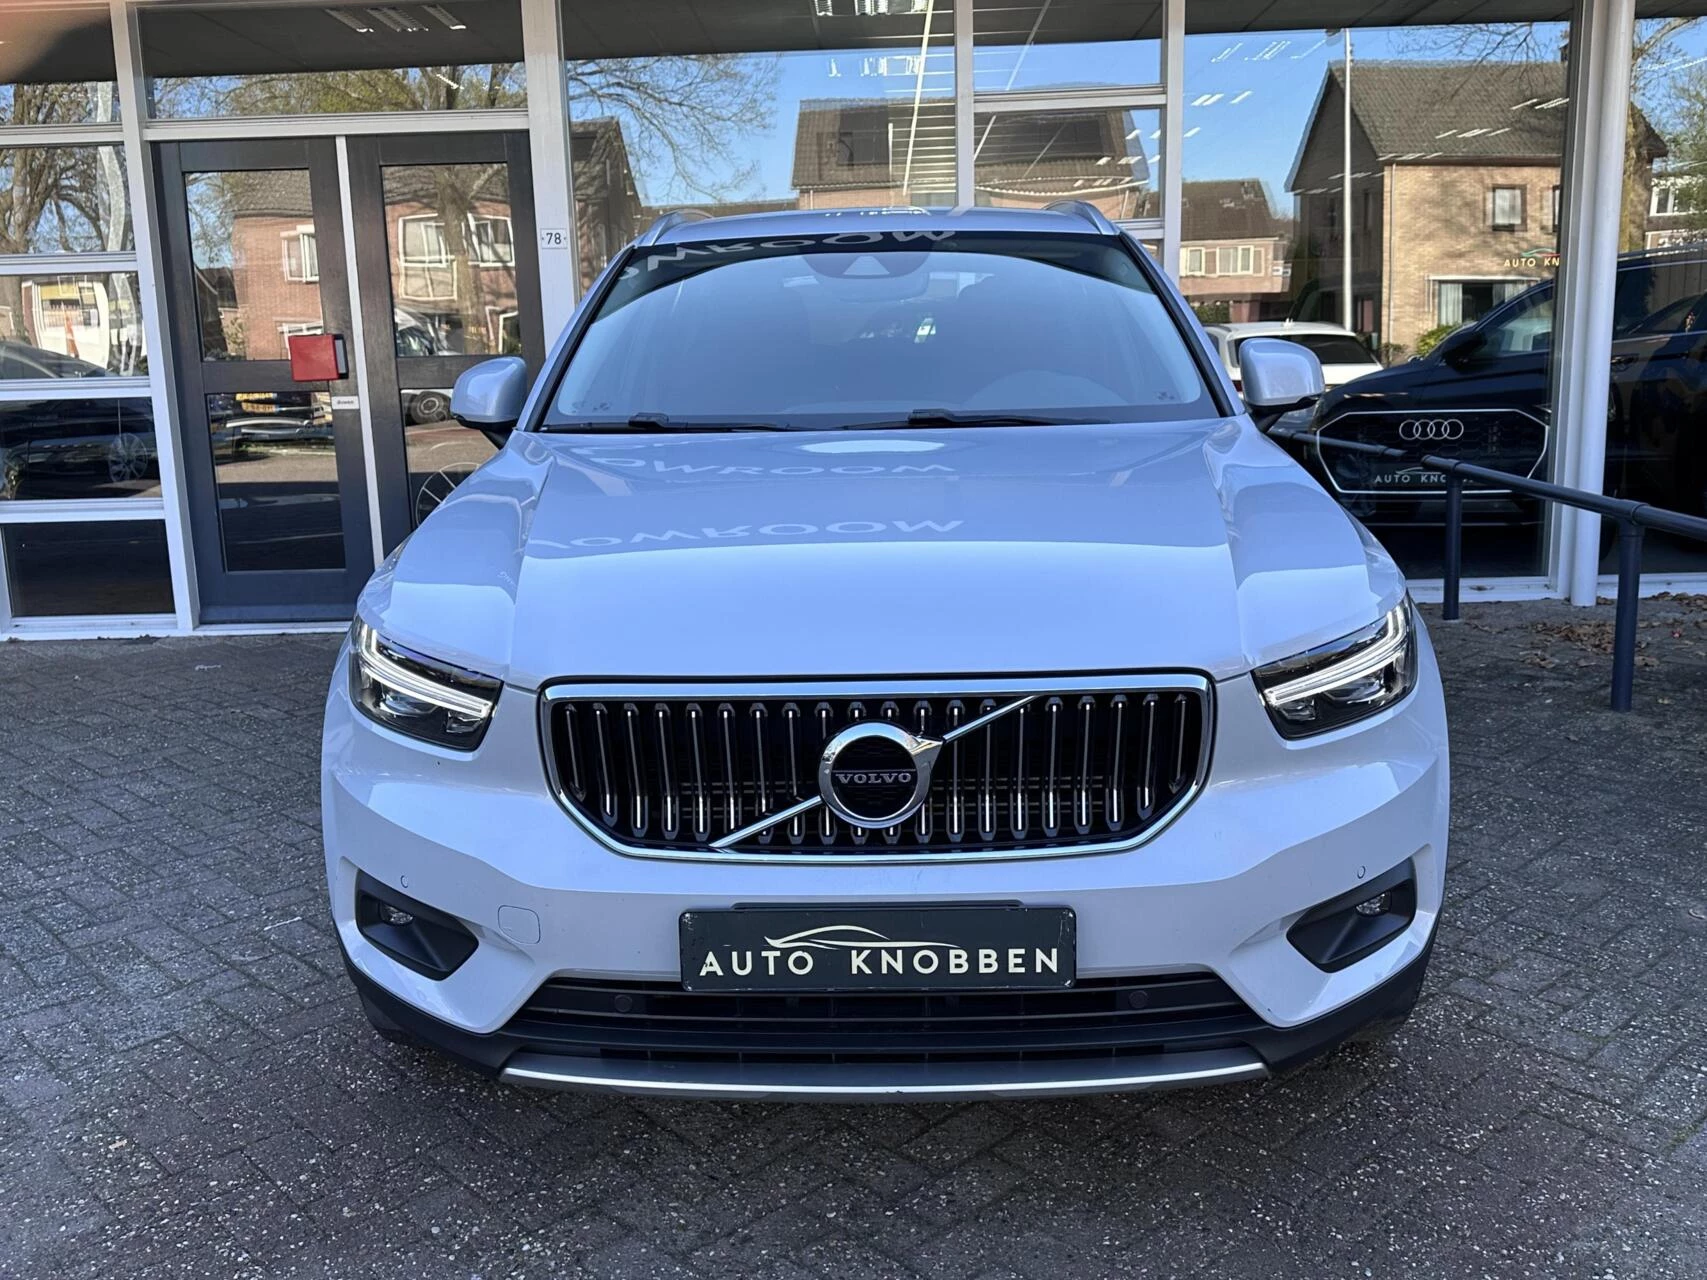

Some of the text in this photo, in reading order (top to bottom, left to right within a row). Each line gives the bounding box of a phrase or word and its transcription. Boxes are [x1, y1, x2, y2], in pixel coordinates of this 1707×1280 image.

[546, 232, 562, 245] 78
[1503, 257, 1537, 268] AUTO
[1374, 474, 1411, 484] AUTO
[835, 772, 912, 785] VOLVO
[699, 947, 1059, 977] AUTO KNOBBEN
